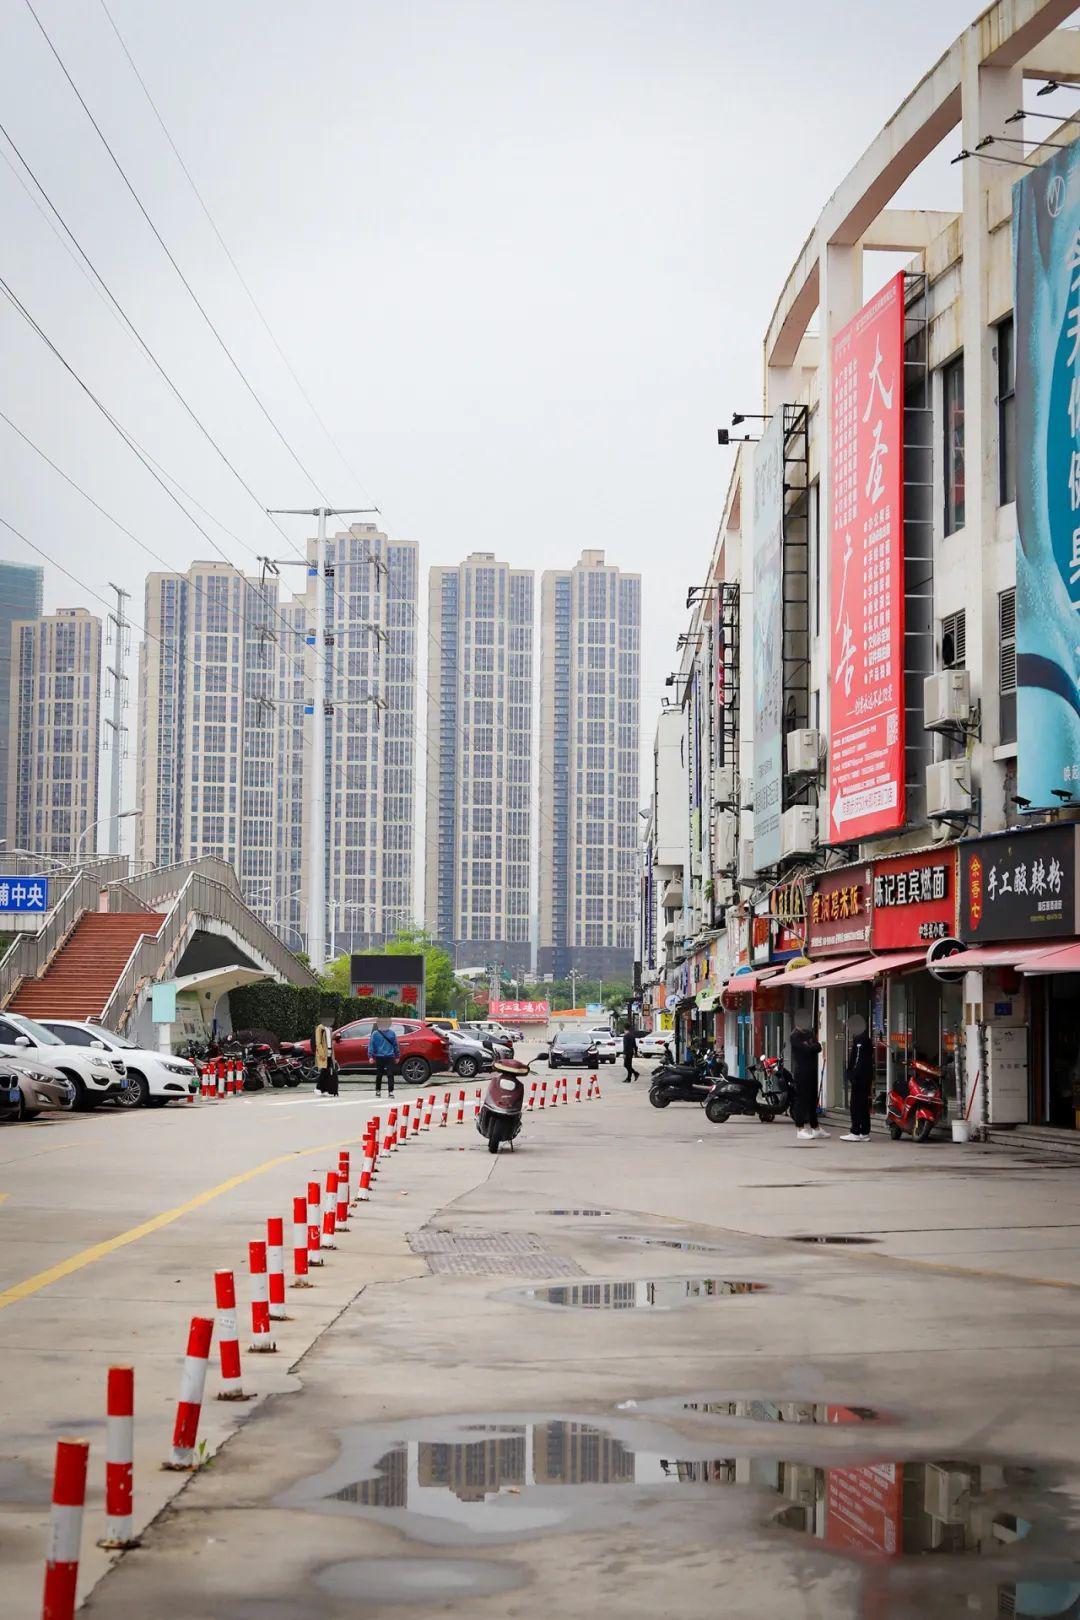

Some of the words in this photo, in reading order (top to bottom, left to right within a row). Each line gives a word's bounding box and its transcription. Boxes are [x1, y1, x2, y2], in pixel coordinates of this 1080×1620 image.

[835, 531, 857, 698] 广告
[874, 866, 945, 907] 陈记宜宾燃面
[987, 857, 1064, 901] 手工酸辣粉
